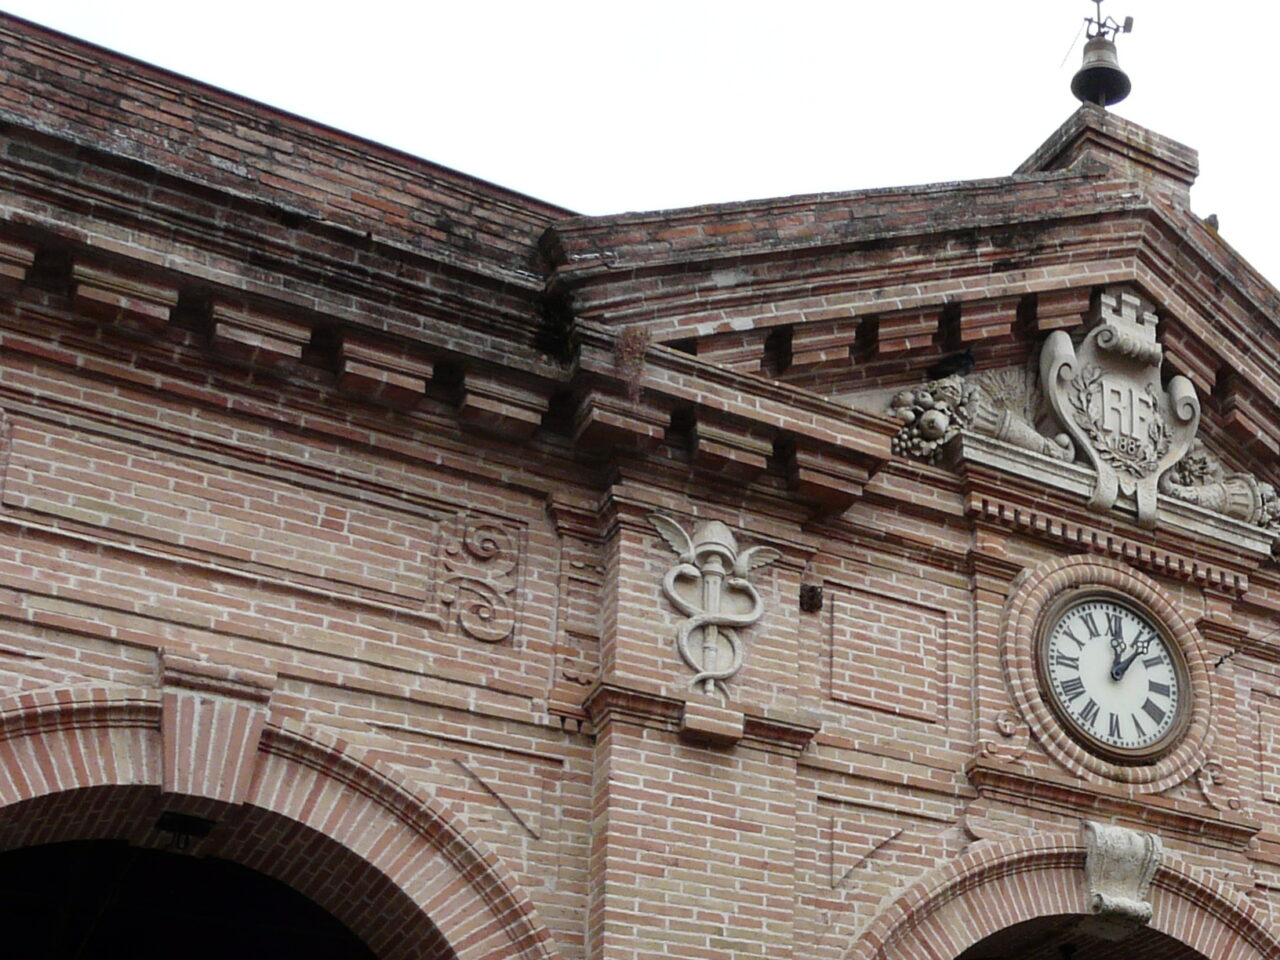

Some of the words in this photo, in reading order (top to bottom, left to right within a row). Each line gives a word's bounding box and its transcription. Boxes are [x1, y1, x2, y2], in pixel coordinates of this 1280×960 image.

[1100, 380, 1152, 441] RF
[1062, 625, 1086, 651] X
[1079, 611, 1101, 640] XI
[1055, 648, 1080, 671] IX
[1141, 655, 1165, 670] II
[1060, 676, 1087, 704] VIII
[1079, 697, 1101, 729] VII
[1107, 712, 1124, 740] VI
[1130, 712, 1147, 739] V
